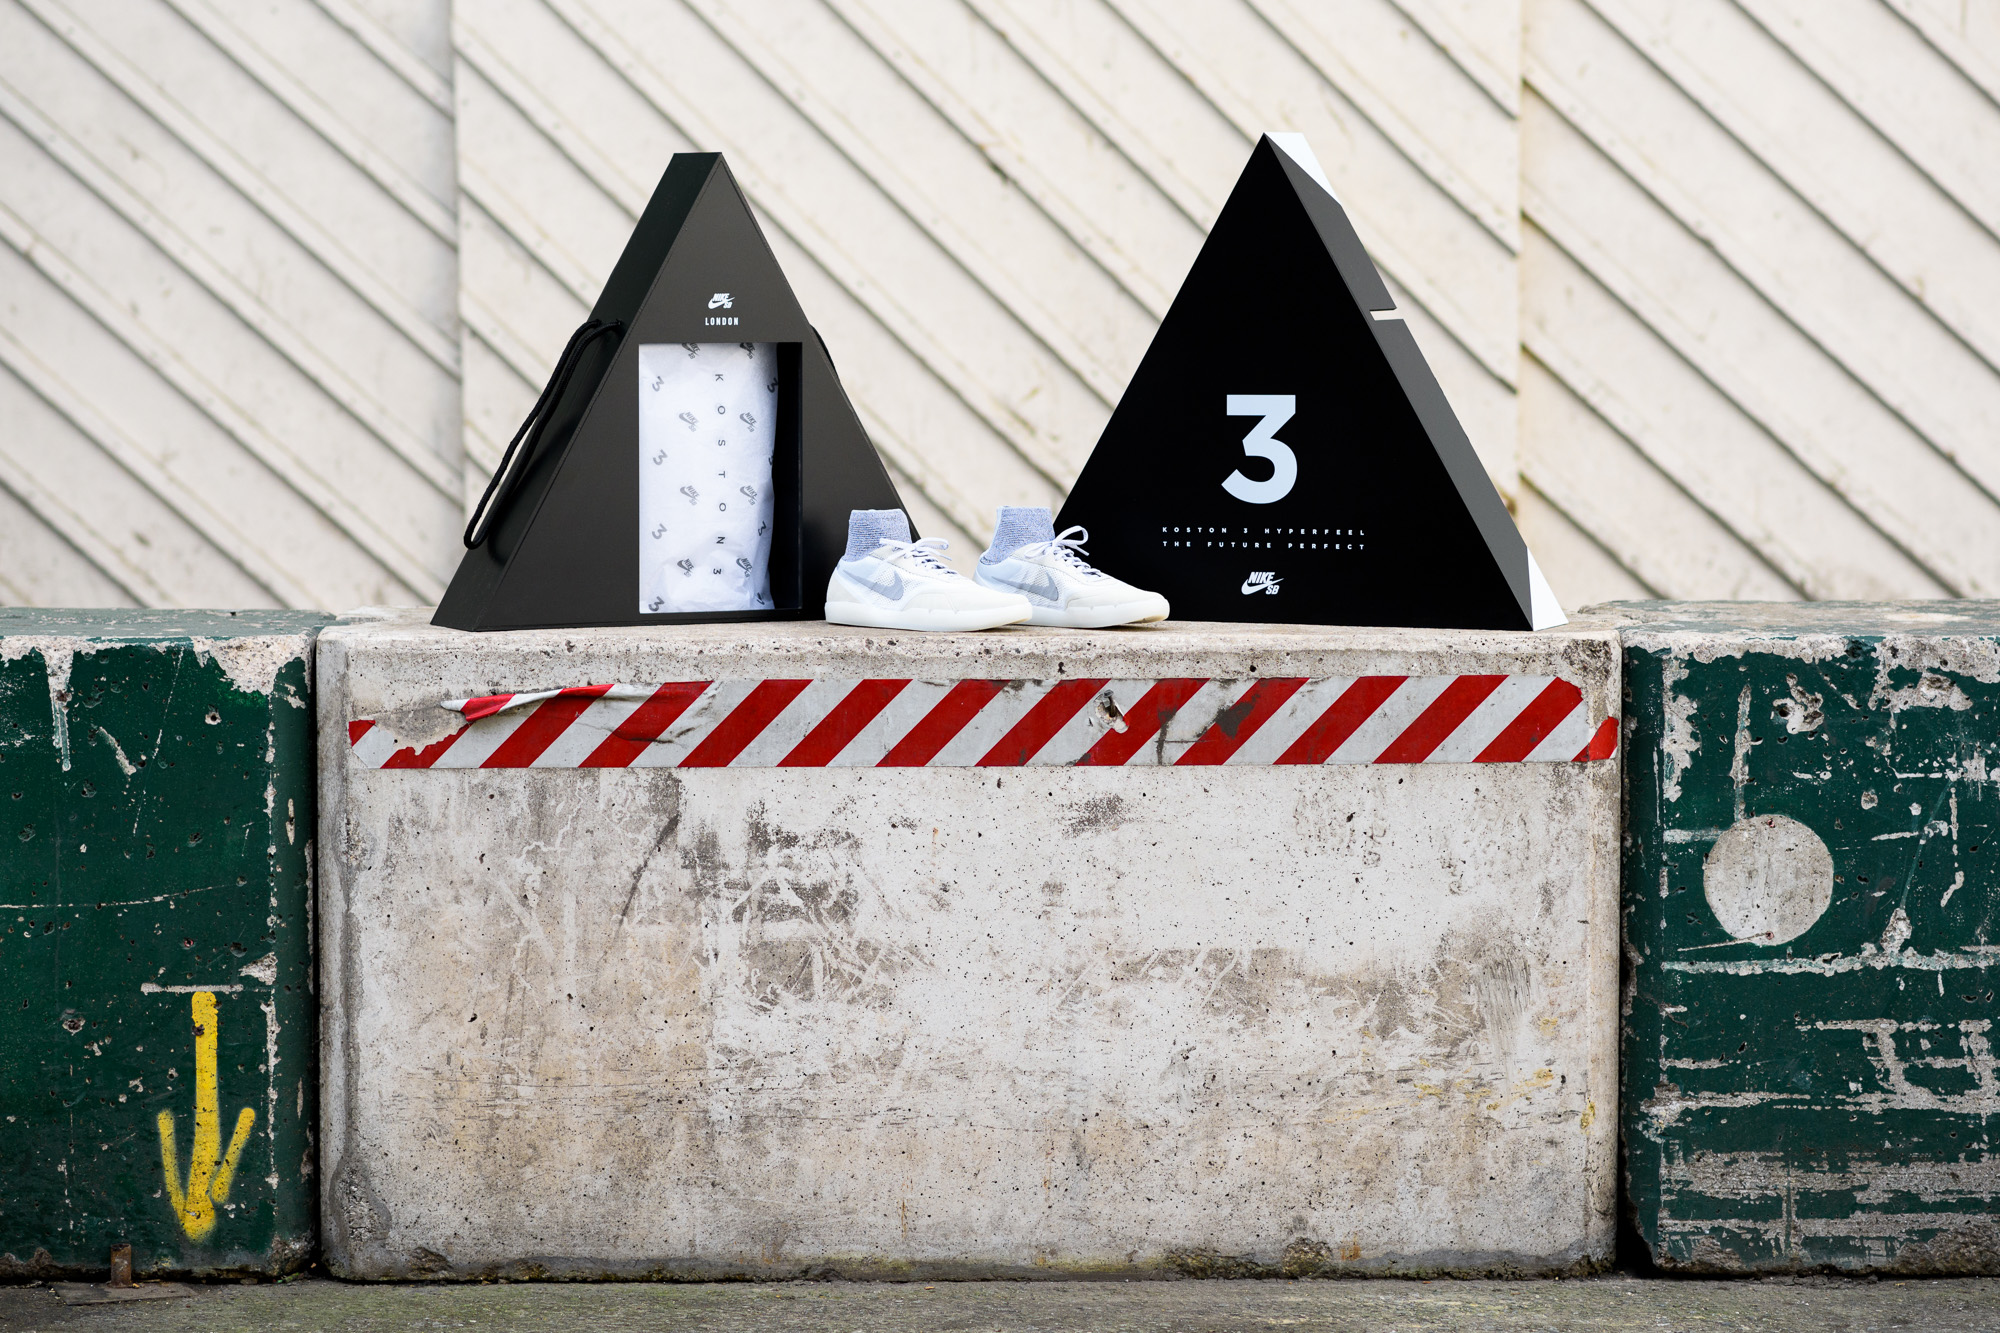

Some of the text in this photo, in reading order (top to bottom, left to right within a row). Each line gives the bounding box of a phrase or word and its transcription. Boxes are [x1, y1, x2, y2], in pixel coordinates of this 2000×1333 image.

[711, 293, 730, 302] NIKE
[705, 317, 739, 326] LONDON
[651, 375, 665, 392] 3
[766, 377, 779, 393] 3
[1221, 394, 1298, 504] 3
[652, 449, 668, 466] 3
[651, 523, 667, 540] 3
[1162, 526, 1227, 534] KOSTON
[1264, 527, 1365, 536] HYPERFEEL
[1207, 541, 1272, 549] FUTURE
[1287, 542, 1365, 550] PERFECT
[1248, 571, 1276, 584] NIKE
[1265, 584, 1280, 595] SB
[648, 596, 665, 612] 3
